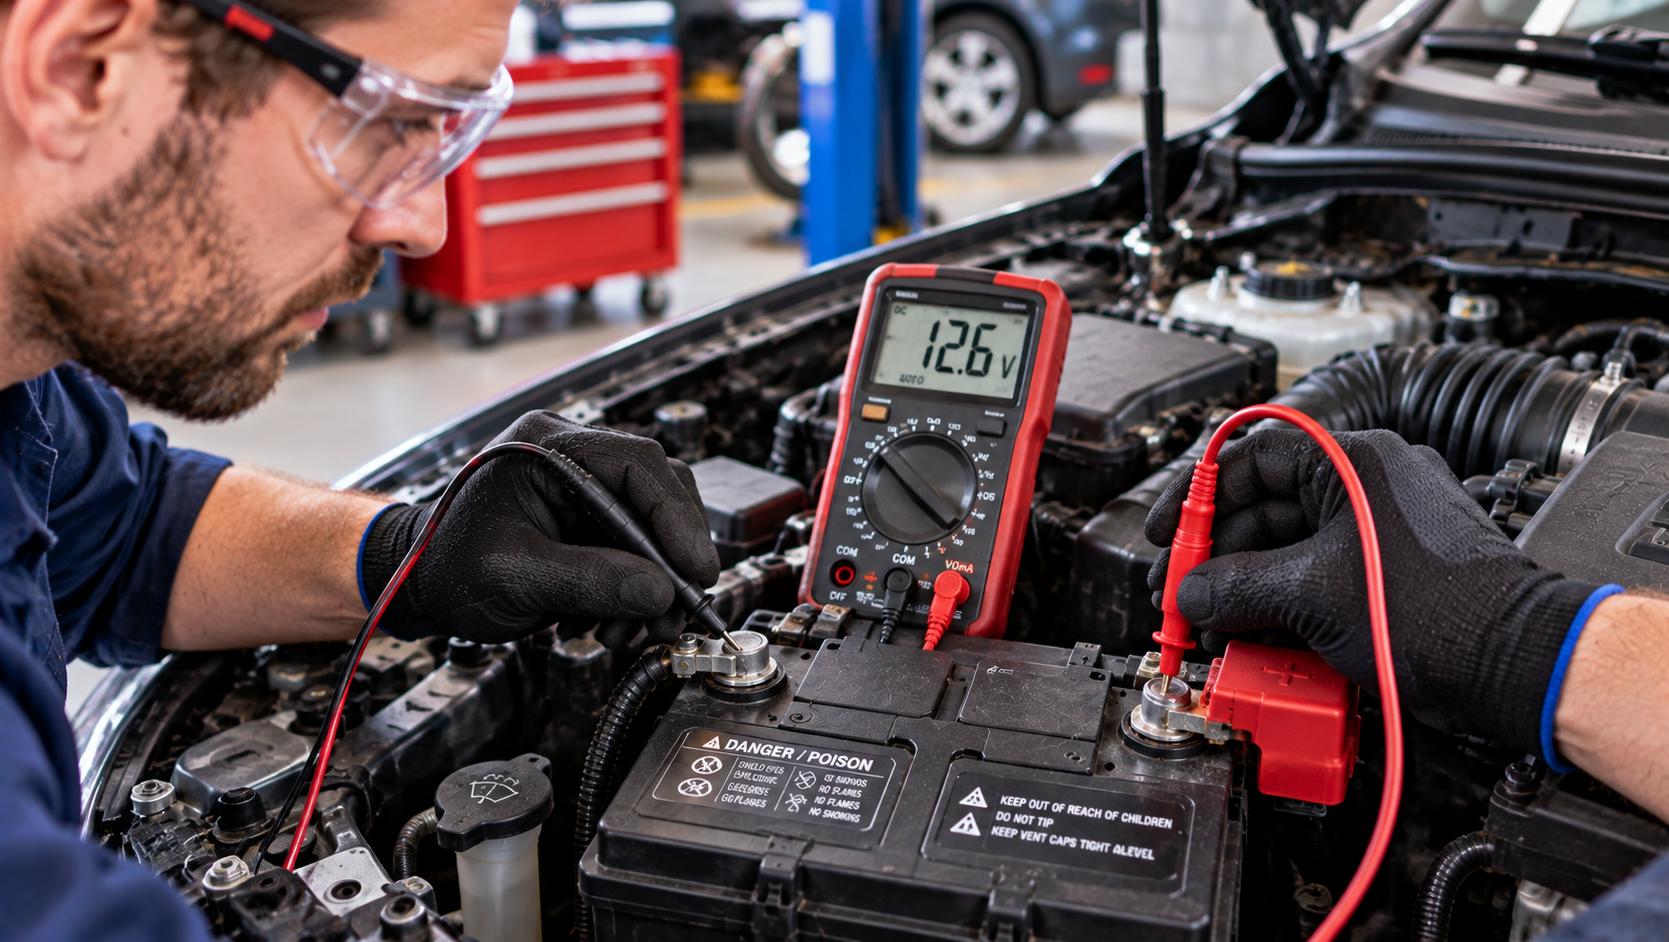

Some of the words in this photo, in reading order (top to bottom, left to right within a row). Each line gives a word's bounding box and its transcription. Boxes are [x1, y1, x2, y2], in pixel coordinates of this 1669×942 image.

[922, 319, 998, 378] 12.6
[1001, 354, 1017, 380] V
[836, 544, 859, 558] COM
[892, 553, 916, 566] COM
[724, 739, 795, 760] DANGER
[807, 751, 874, 772] POISON
[996, 811, 1011, 822] DO
[1013, 813, 1036, 825] NOT
[1037, 816, 1054, 828] TIP
[1000, 795, 1027, 808] KEEP
[1028, 799, 1050, 811] OUT
[1051, 802, 1066, 813] OF
[1066, 804, 1102, 818] REACH
[1104, 809, 1120, 821] OF
[1121, 811, 1173, 829] CHILDREN
[991, 825, 1018, 838] KEEP
[1020, 829, 1048, 843] VENT
[1049, 834, 1077, 848] CAPS
[1080, 838, 1111, 853] TIGHT
